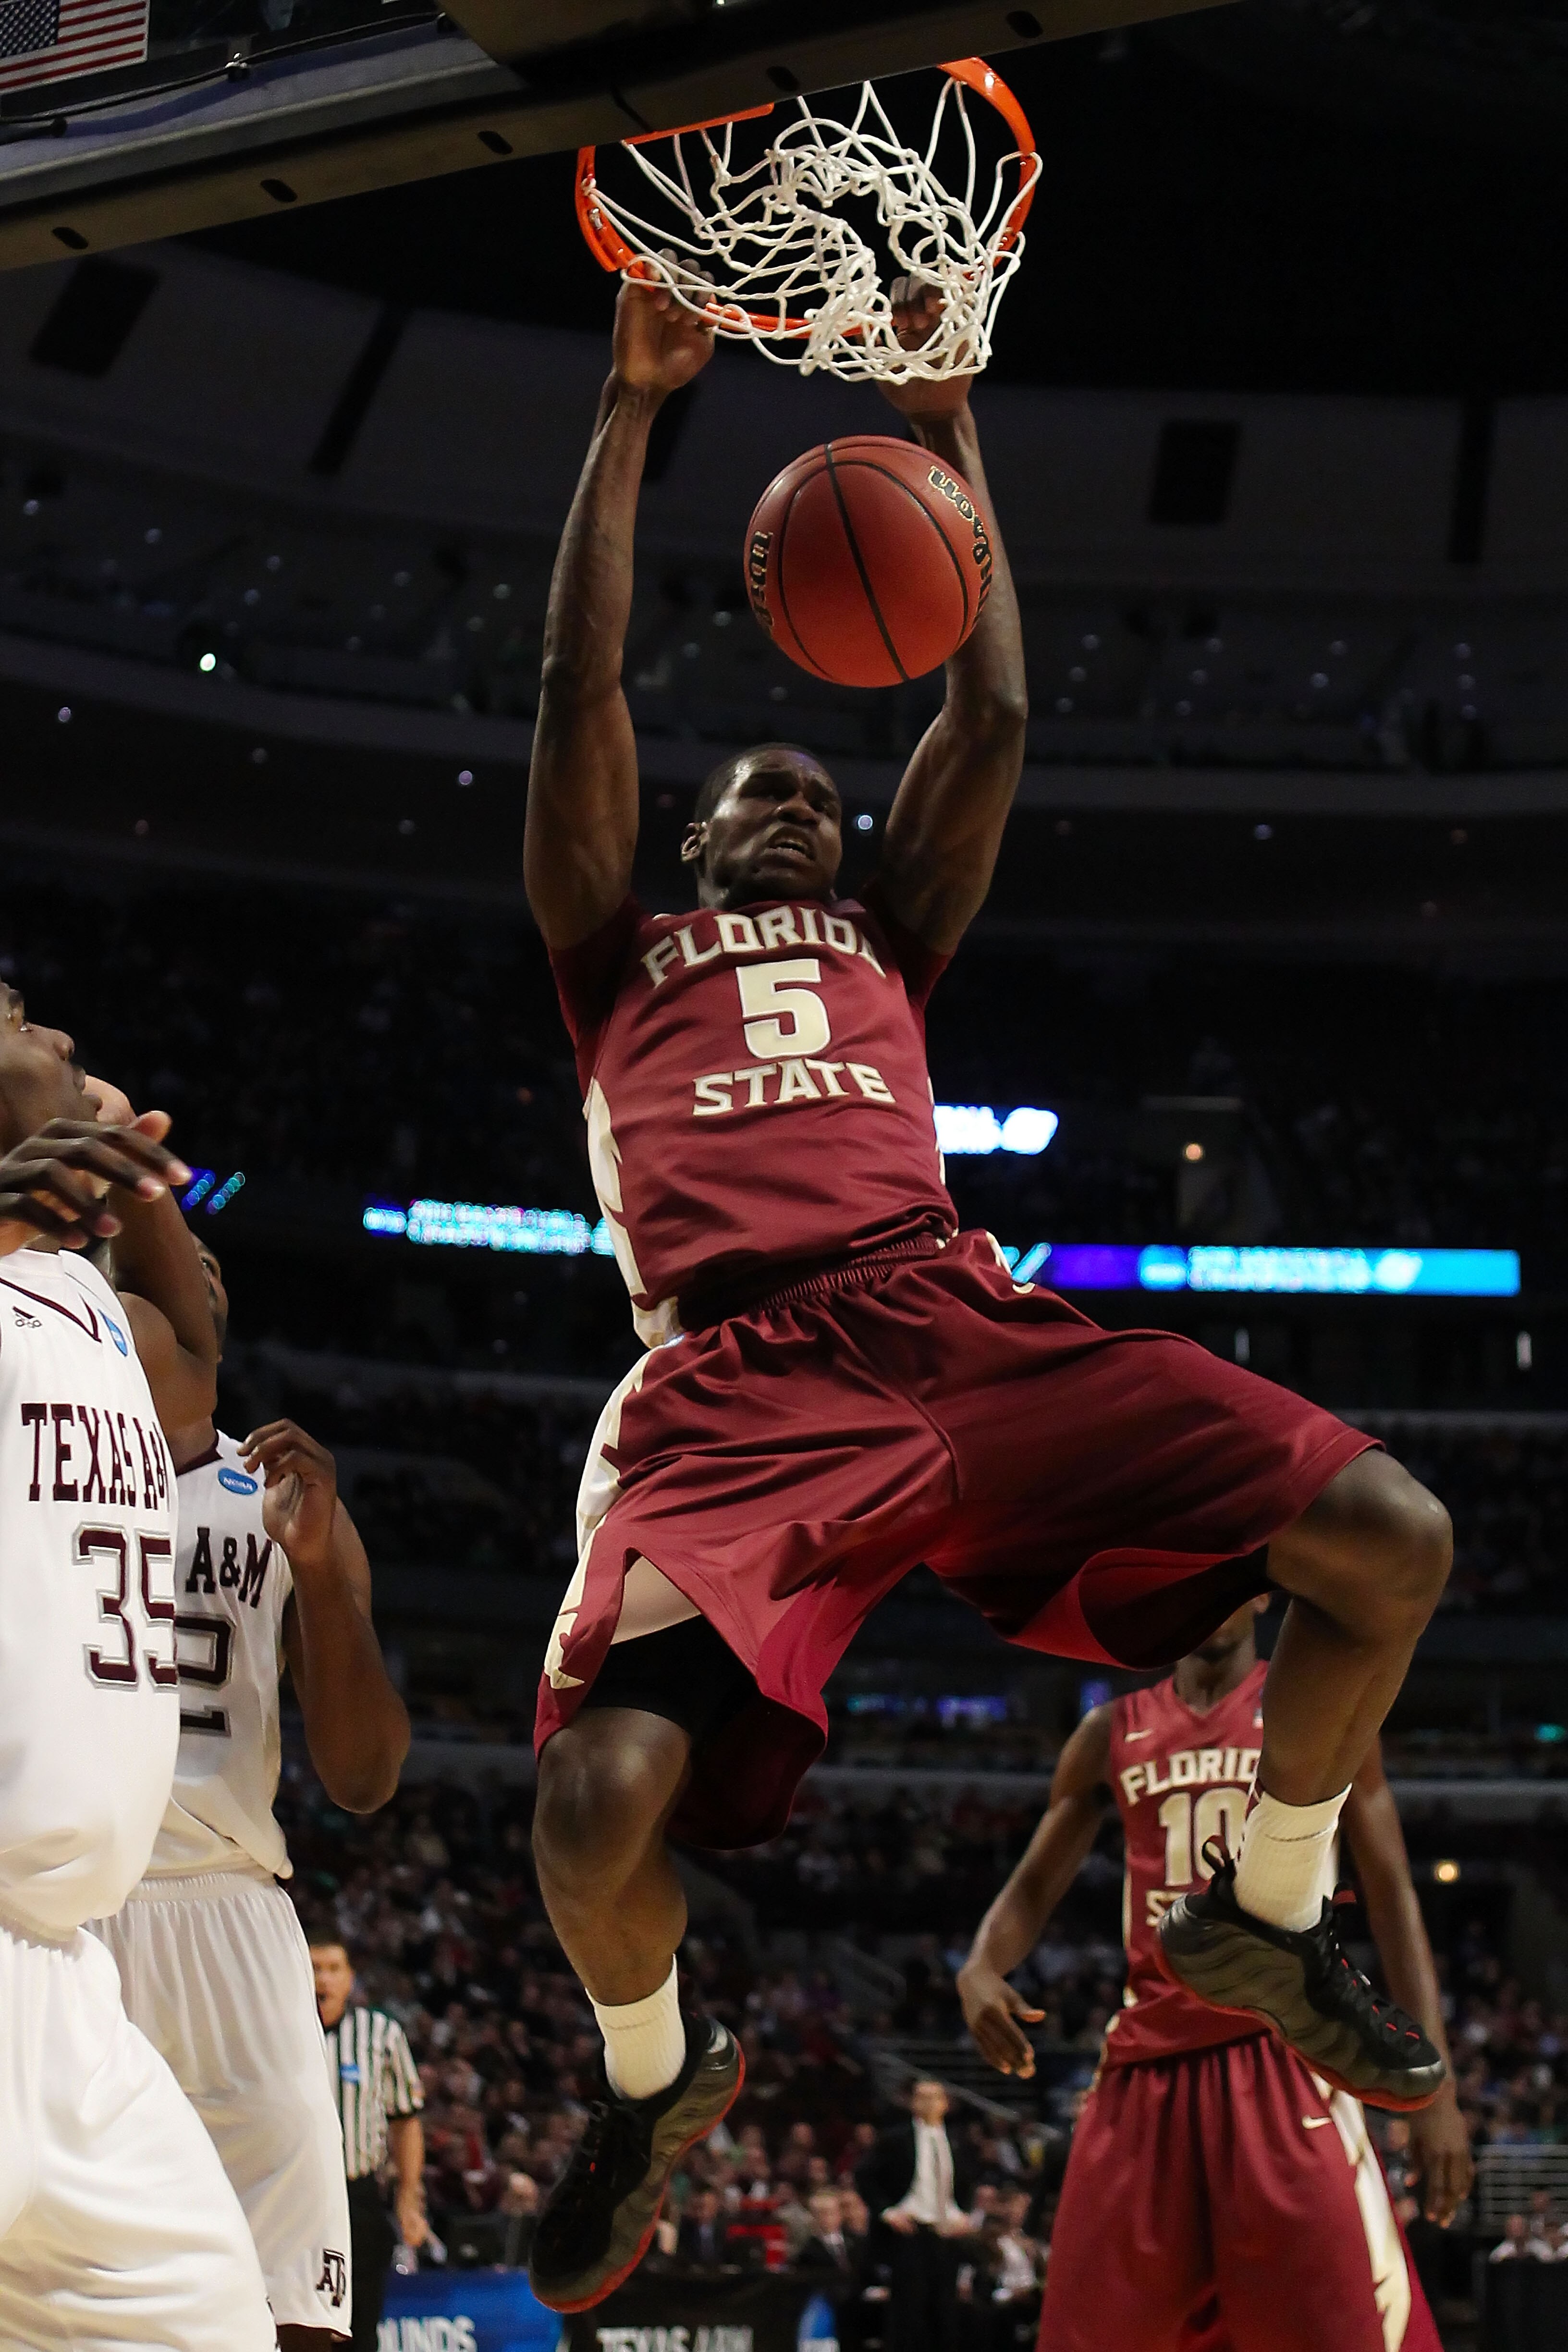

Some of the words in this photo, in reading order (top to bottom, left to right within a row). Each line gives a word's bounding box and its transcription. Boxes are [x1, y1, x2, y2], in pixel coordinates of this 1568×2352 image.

[735, 958, 832, 1059] 5
[692, 1058, 896, 1117] STATE
[21, 1403, 135, 1507] TEXAS
[71, 1519, 178, 1693] 35
[185, 1527, 272, 1608] A&M
[1120, 1748, 1262, 1807] FLORID
[1158, 1787, 1251, 1886] 10
